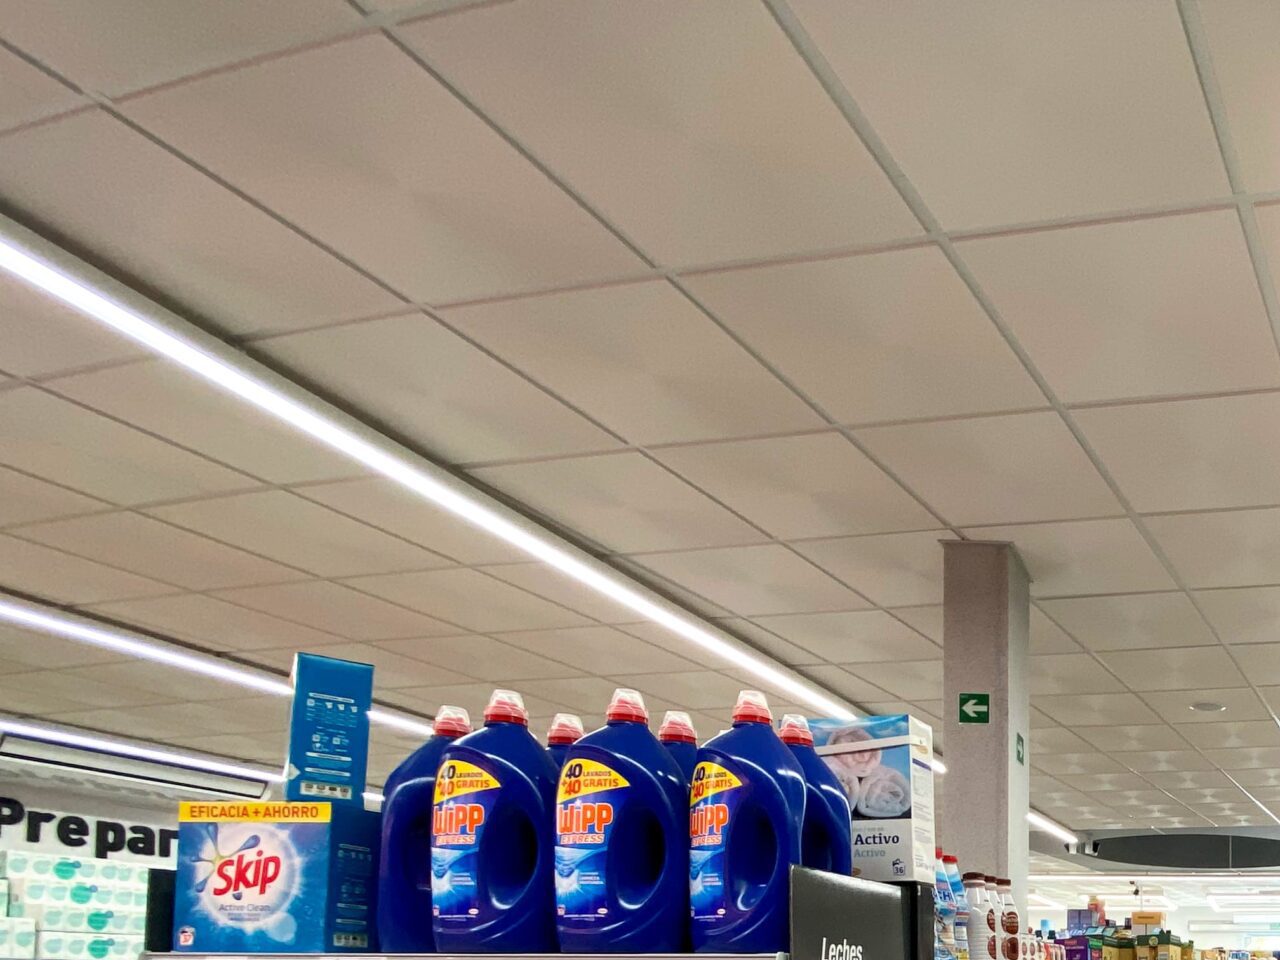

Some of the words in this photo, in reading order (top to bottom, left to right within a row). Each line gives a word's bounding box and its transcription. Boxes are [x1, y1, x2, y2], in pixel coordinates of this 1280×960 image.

[565, 763, 582, 779] 40
[456, 779, 490, 788] GRATIS
[583, 778, 619, 788] GRATIS
[705, 779, 732, 789] GRATIS
[190, 806, 249, 818] EFICACIA
[263, 806, 319, 818] AHORRO
[560, 833, 605, 845] EXPRESS
[854, 833, 900, 846] Activo
[854, 848, 886, 858] Activo
[893, 865, 904, 875] 36
[218, 904, 244, 912] Active
